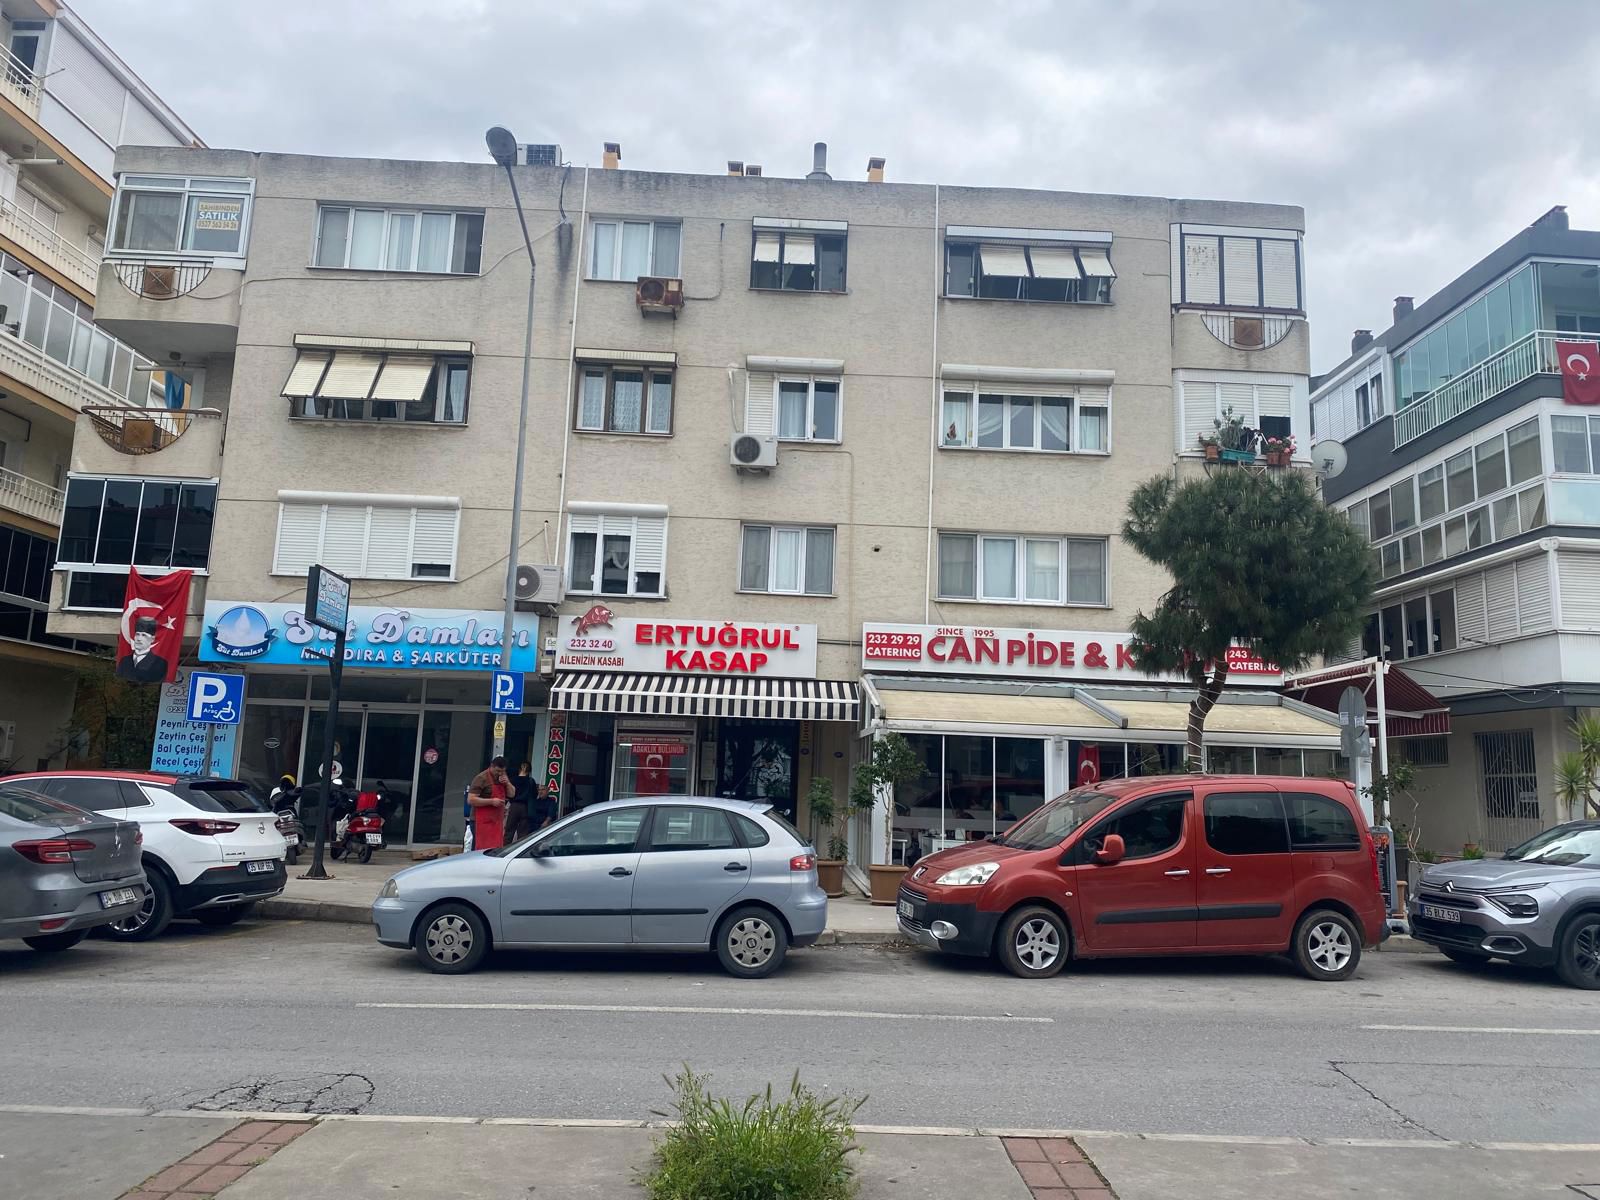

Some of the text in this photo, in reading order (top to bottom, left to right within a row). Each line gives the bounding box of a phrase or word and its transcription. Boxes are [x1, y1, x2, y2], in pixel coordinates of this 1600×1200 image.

[200, 212, 238, 220] SATILIK
[635, 621, 800, 650] ERTUĞRUL
[937, 628, 995, 637] SINCE 1995
[570, 639, 613, 649] 232 32 40
[868, 634, 920, 645] 232 29 29
[392, 650, 405, 662] &
[866, 647, 921, 658] CATERING
[927, 635, 1000, 664] CAN
[1006, 632, 1076, 668] PİDE
[1083, 642, 1110, 669] &
[1229, 650, 1248, 659] 243
[597, 656, 625, 667] KASABI
[665, 650, 768, 673] KASAP
[494, 674, 514, 708] P
[192, 676, 227, 718] P
[160, 720, 189, 730] Peynir
[159, 732, 186, 742] Zeytin
[157, 744, 171, 753] Bal
[155, 757, 180, 767] Reçel
[1425, 906, 1433, 916] 35
[1447, 910, 1460, 921] 539
